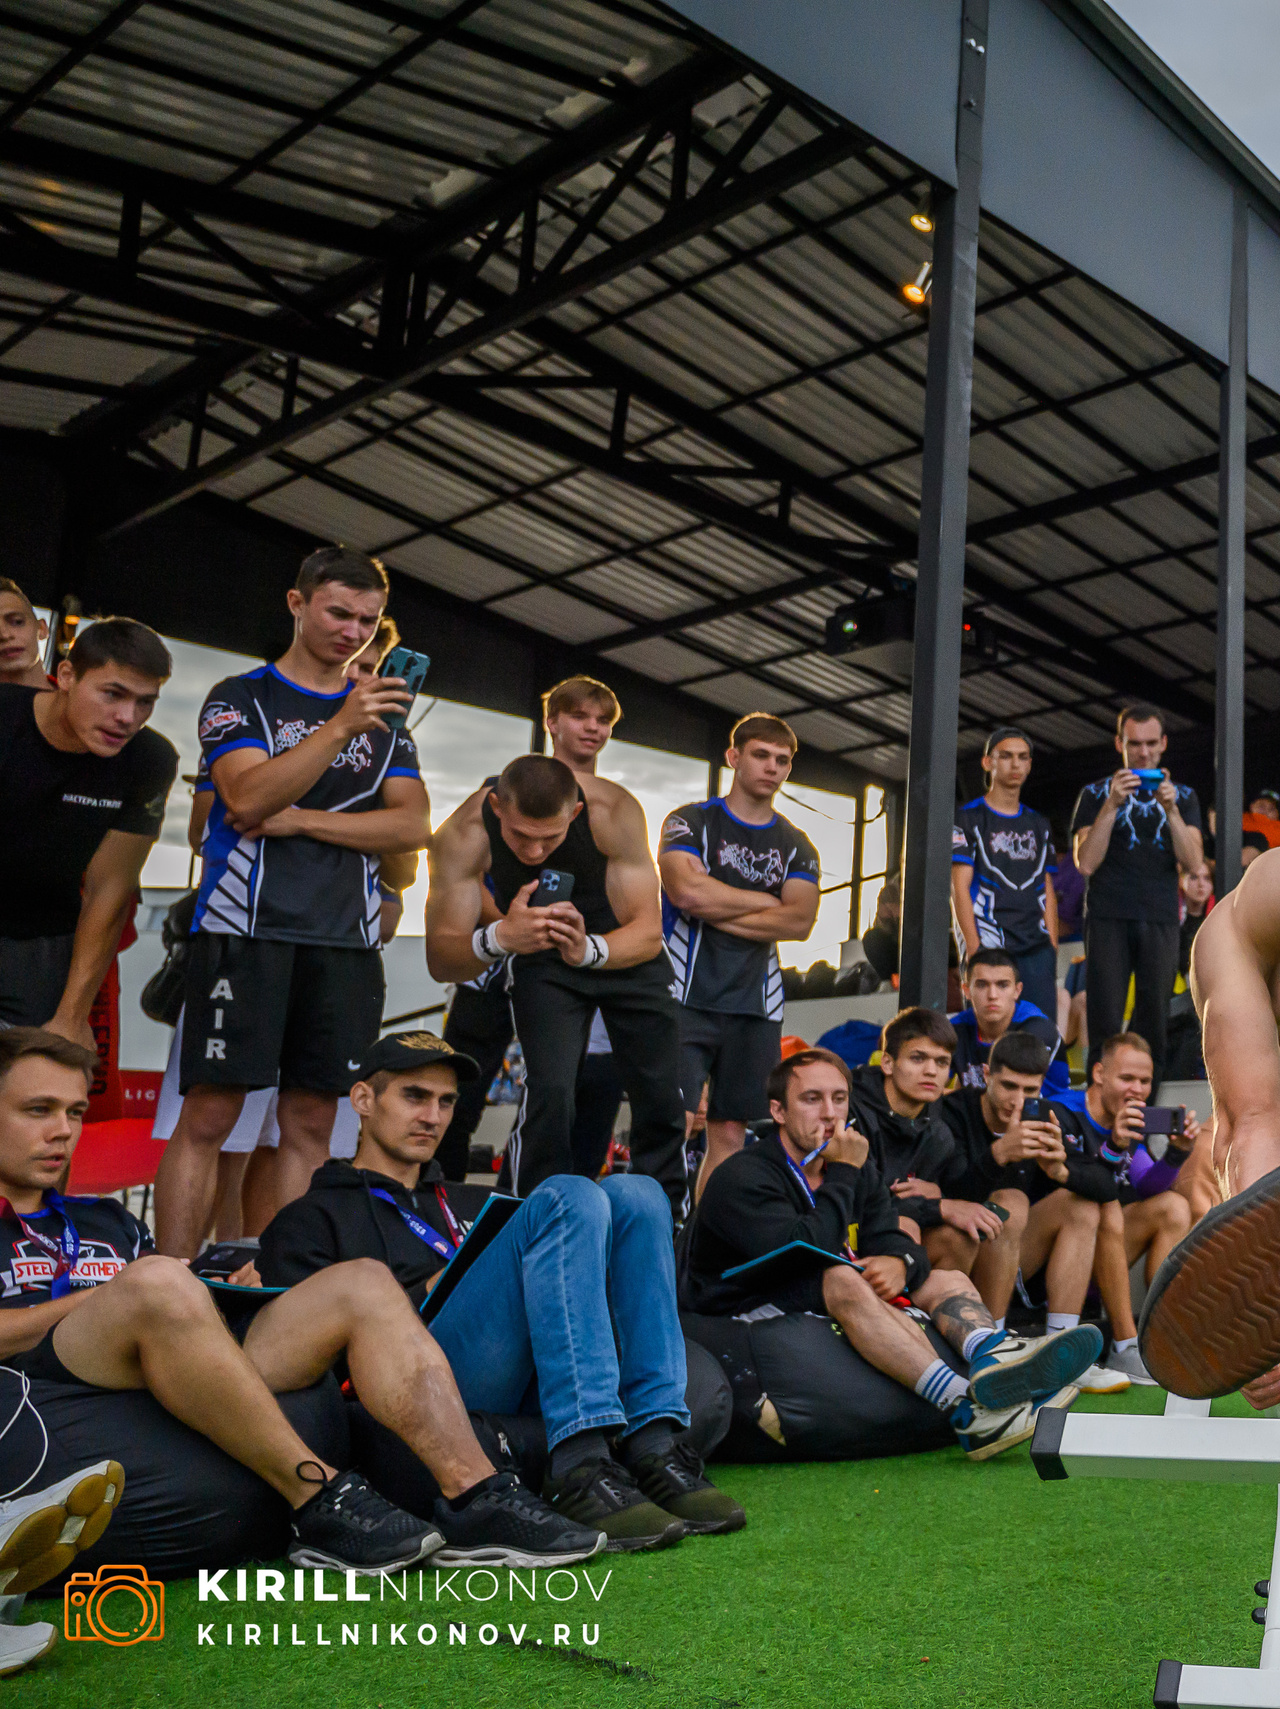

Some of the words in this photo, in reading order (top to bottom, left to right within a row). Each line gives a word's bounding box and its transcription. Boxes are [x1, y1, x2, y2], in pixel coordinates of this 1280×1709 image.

[205, 978, 234, 1060] AIR
[14, 1261, 55, 1278] STEEL
[69, 1262, 126, 1277] ROTHER
